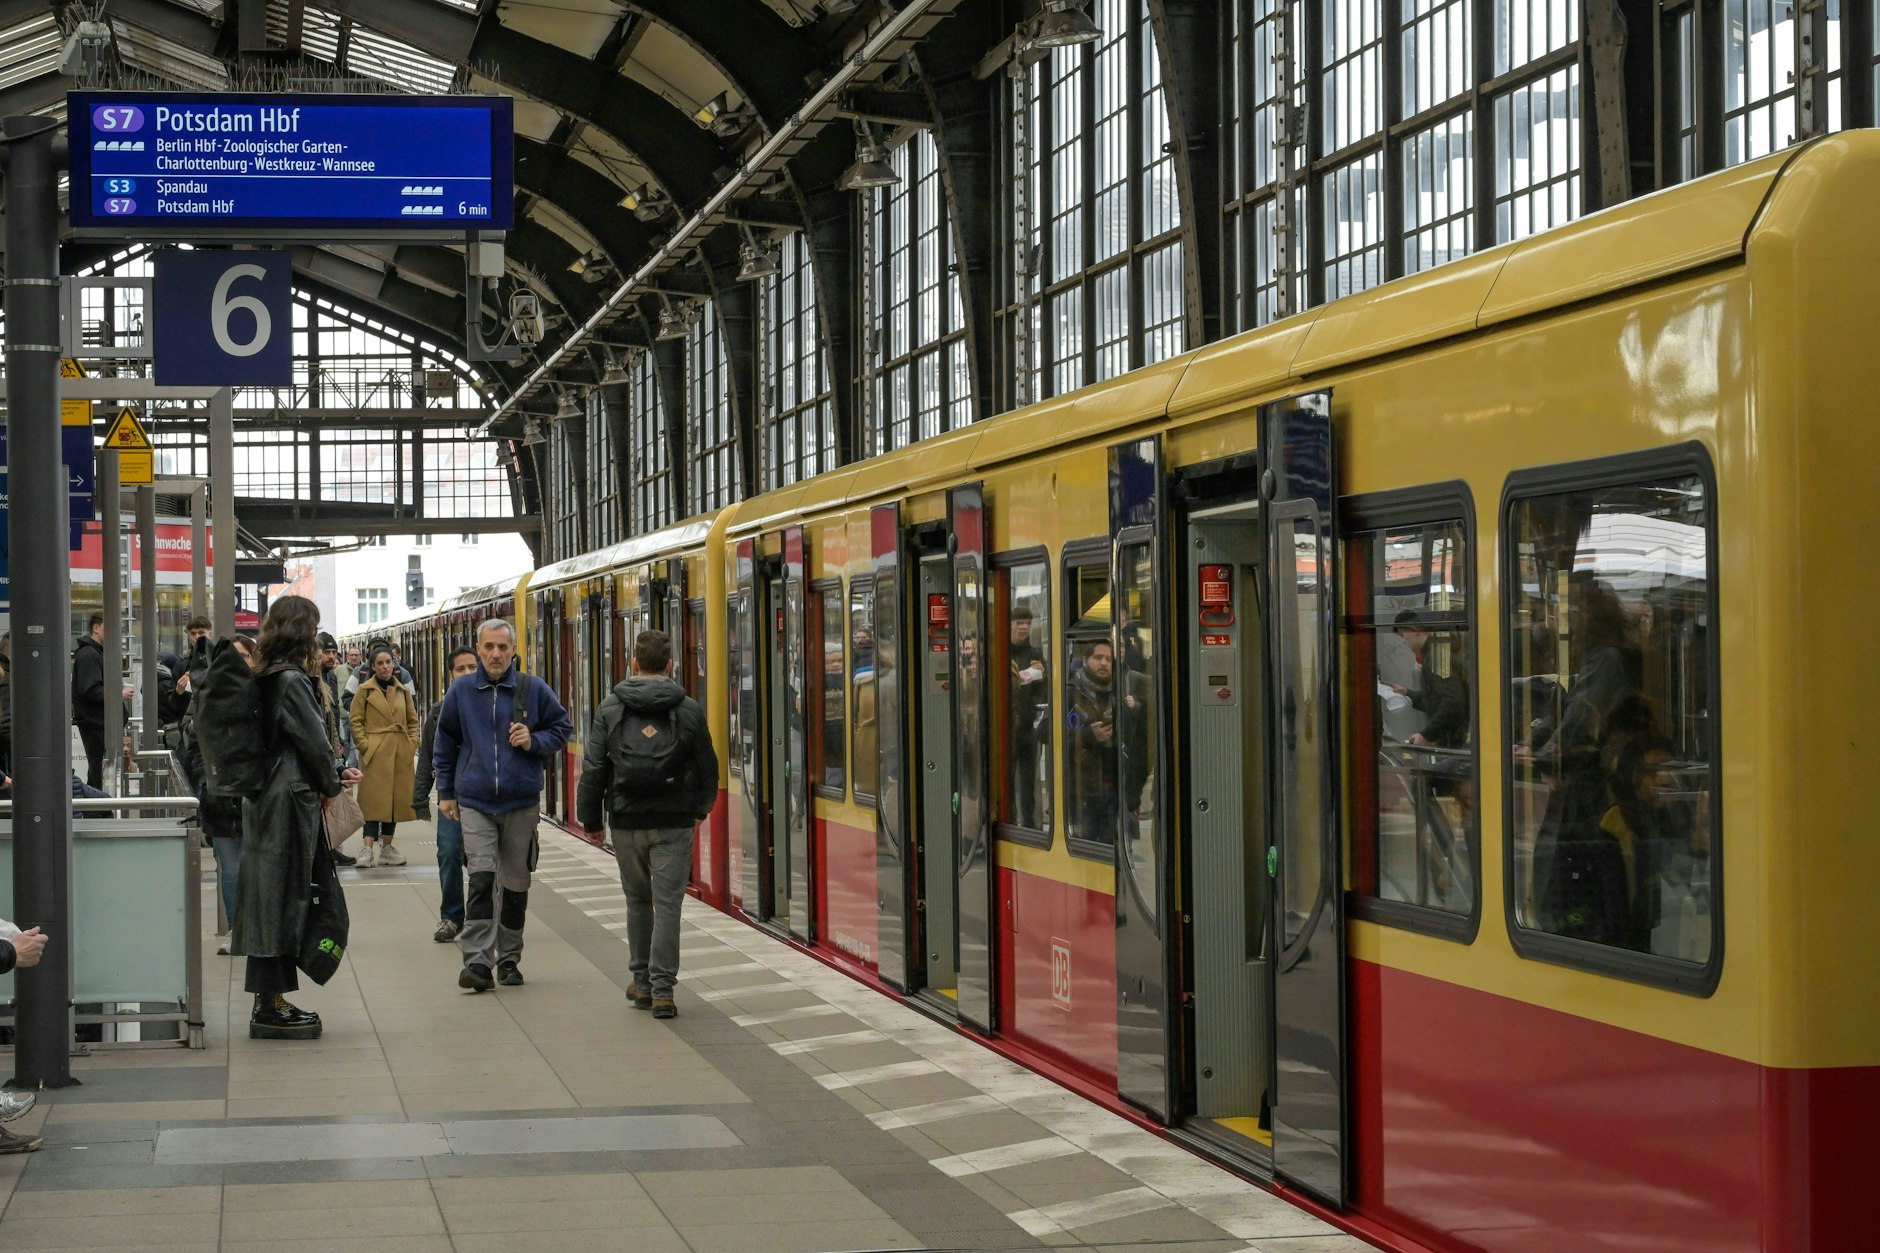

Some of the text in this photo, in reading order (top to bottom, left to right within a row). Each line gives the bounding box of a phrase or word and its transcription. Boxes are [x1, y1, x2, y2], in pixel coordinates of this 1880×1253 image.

[156, 106, 300, 132] Potsdam Hbf
[156, 138, 192, 152] Berlin
[109, 179, 130, 193] S3
[156, 179, 208, 197] Spandau
[110, 199, 130, 213] S7
[157, 199, 235, 214] Potsdam Hbf
[458, 201, 488, 216] 6 min
[211, 264, 273, 357] 6
[1053, 947, 1070, 1000] DB
